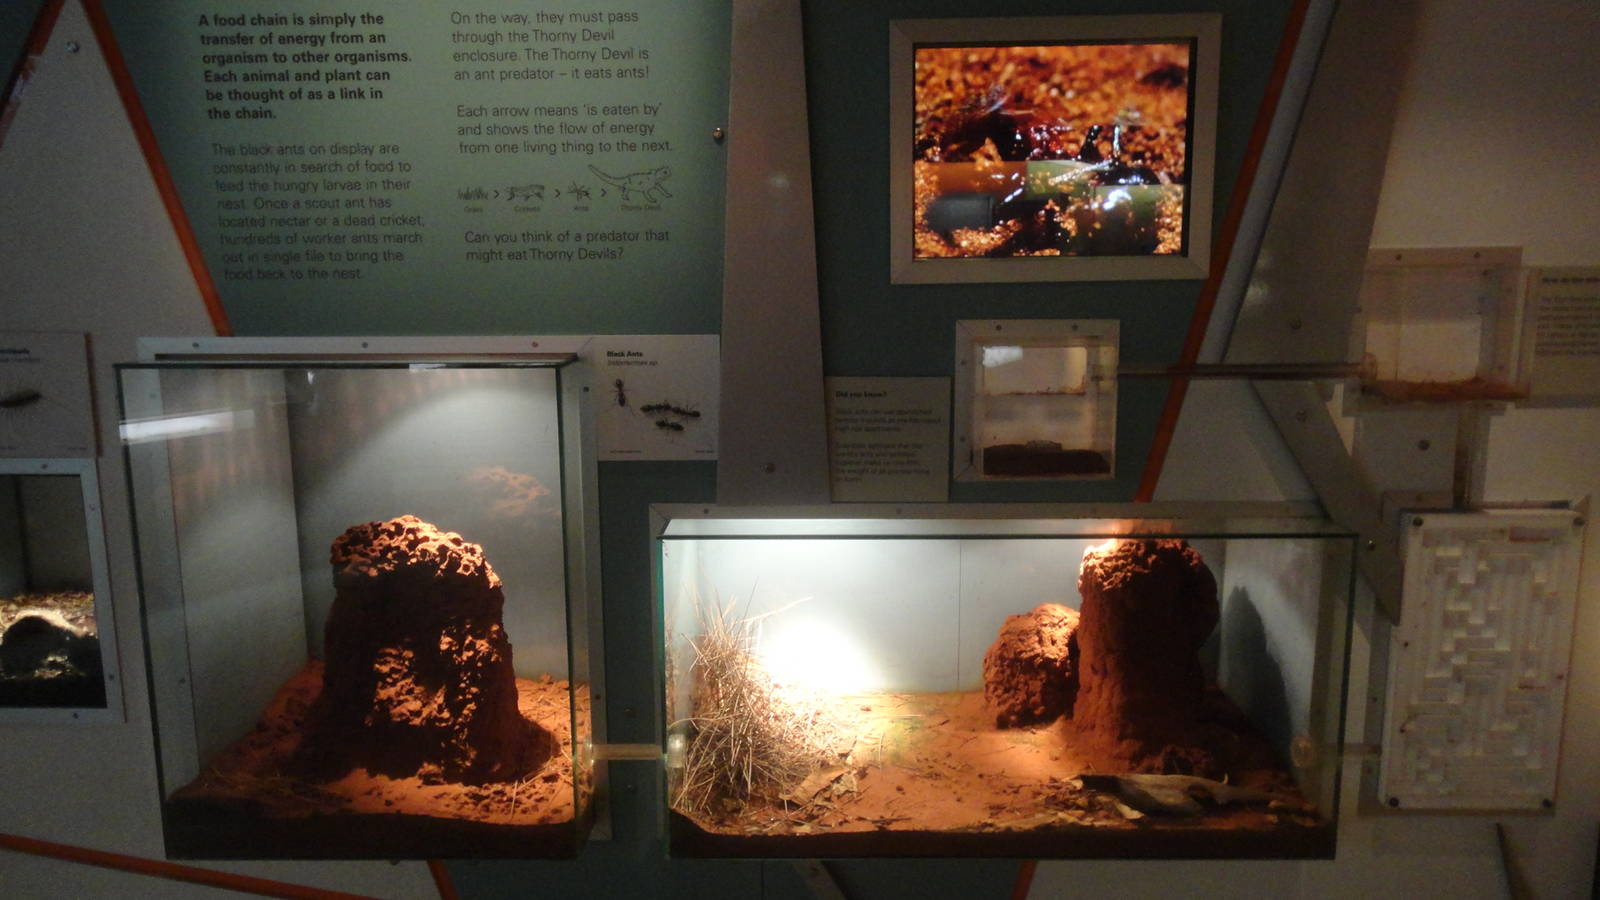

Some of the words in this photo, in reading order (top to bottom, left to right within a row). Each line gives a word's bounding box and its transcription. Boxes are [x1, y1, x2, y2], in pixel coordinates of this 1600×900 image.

[198, 14, 209, 26] A
[213, 14, 245, 26] food
[250, 14, 288, 26] chain
[293, 13, 304, 25] is
[309, 13, 355, 28] simply
[360, 13, 383, 25] the
[451, 12, 471, 24] On
[475, 12, 496, 24] the
[536, 11, 564, 26] they
[569, 12, 603, 23] must
[608, 13, 639, 25] pass
[201, 32, 254, 45] transfer
[260, 32, 273, 44] of
[278, 34, 325, 47] energy
[330, 31, 364, 44] from
[369, 33, 385, 43] an
[452, 30, 503, 45] through
[508, 30, 528, 42] the
[532, 29, 577, 44] Thorny
[582, 29, 615, 41] Devil
[202, 51, 268, 66] organism
[273, 52, 287, 63] to
[292, 51, 331, 63] other
[334, 50, 412, 65] organisms.
[524, 49, 548, 61] The
[551, 48, 596, 63] Thorny
[601, 48, 633, 60] Devil
[638, 48, 649, 60] is
[204, 70, 237, 82] Each
[242, 69, 290, 82] animal
[295, 69, 320, 81] and
[326, 69, 361, 83] plant
[366, 71, 390, 81] can
[454, 71, 470, 80] an
[474, 69, 495, 80] ant
[500, 67, 555, 82] predator
[571, 67, 580, 79] it
[584, 68, 612, 79] eats
[616, 66, 649, 79] ants!
[207, 89, 223, 101] be
[228, 88, 283, 103] thought
[289, 88, 303, 100] of
[307, 90, 323, 100] as
[328, 90, 335, 100] a
[340, 87, 365, 99] link
[370, 87, 383, 99] in
[207, 107, 231, 120] the
[235, 107, 276, 119] chain.
[457, 105, 488, 117] Each
[492, 107, 530, 117] arrow
[534, 106, 578, 116] means
[602, 104, 639, 116] eaten
[458, 123, 482, 136] and
[486, 123, 529, 135] shows
[534, 123, 554, 135] the
[559, 122, 587, 134] flow
[592, 122, 605, 134] of
[610, 124, 655, 136] energy
[212, 143, 235, 156] The
[277, 144, 304, 155] ants
[309, 145, 324, 155] on
[330, 142, 375, 157] display
[379, 144, 399, 154] are
[459, 141, 490, 154] from
[495, 143, 519, 153] one
[523, 140, 556, 155] living
[561, 140, 594, 155] thing
[598, 141, 612, 152] to
[616, 139, 637, 152] the
[214, 161, 280, 176] constantly
[285, 161, 296, 173] in
[300, 161, 342, 173] search
[347, 160, 360, 173] of
[364, 160, 393, 172] food
[398, 161, 411, 172] to
[249, 179, 268, 192] the
[273, 179, 318, 194] hungry
[323, 178, 361, 191] larvae
[366, 178, 377, 190] in
[382, 178, 410, 190] their
[253, 197, 288, 209] Once
[292, 199, 300, 209] a
[305, 197, 340, 209] scout
[345, 197, 365, 208] ant
[369, 196, 392, 208] has
[219, 215, 265, 227] located
[271, 216, 309, 227] nectar
[314, 217, 328, 227] or
[332, 217, 340, 226] a
[344, 214, 375, 226] dead
[285, 232, 297, 244] of
[302, 232, 346, 244] worker
[351, 232, 378, 244] ants
[383, 231, 422, 243] march
[464, 231, 490, 243] Can
[494, 233, 517, 245] you
[521, 230, 552, 243] think
[557, 230, 570, 242] of
[575, 232, 582, 242] a
[586, 229, 641, 244] predator
[645, 229, 670, 241] that
[248, 250, 259, 262] in
[263, 250, 300, 265] single
[305, 250, 325, 262] file
[329, 250, 341, 262] to
[346, 249, 378, 264] bring
[383, 249, 404, 261] the
[467, 249, 502, 264] might
[507, 250, 528, 261] eat
[530, 248, 574, 263] Thorny
[578, 247, 624, 260] Devils?
[224, 268, 252, 281] food
[290, 268, 303, 280] to
[308, 267, 328, 279] the
